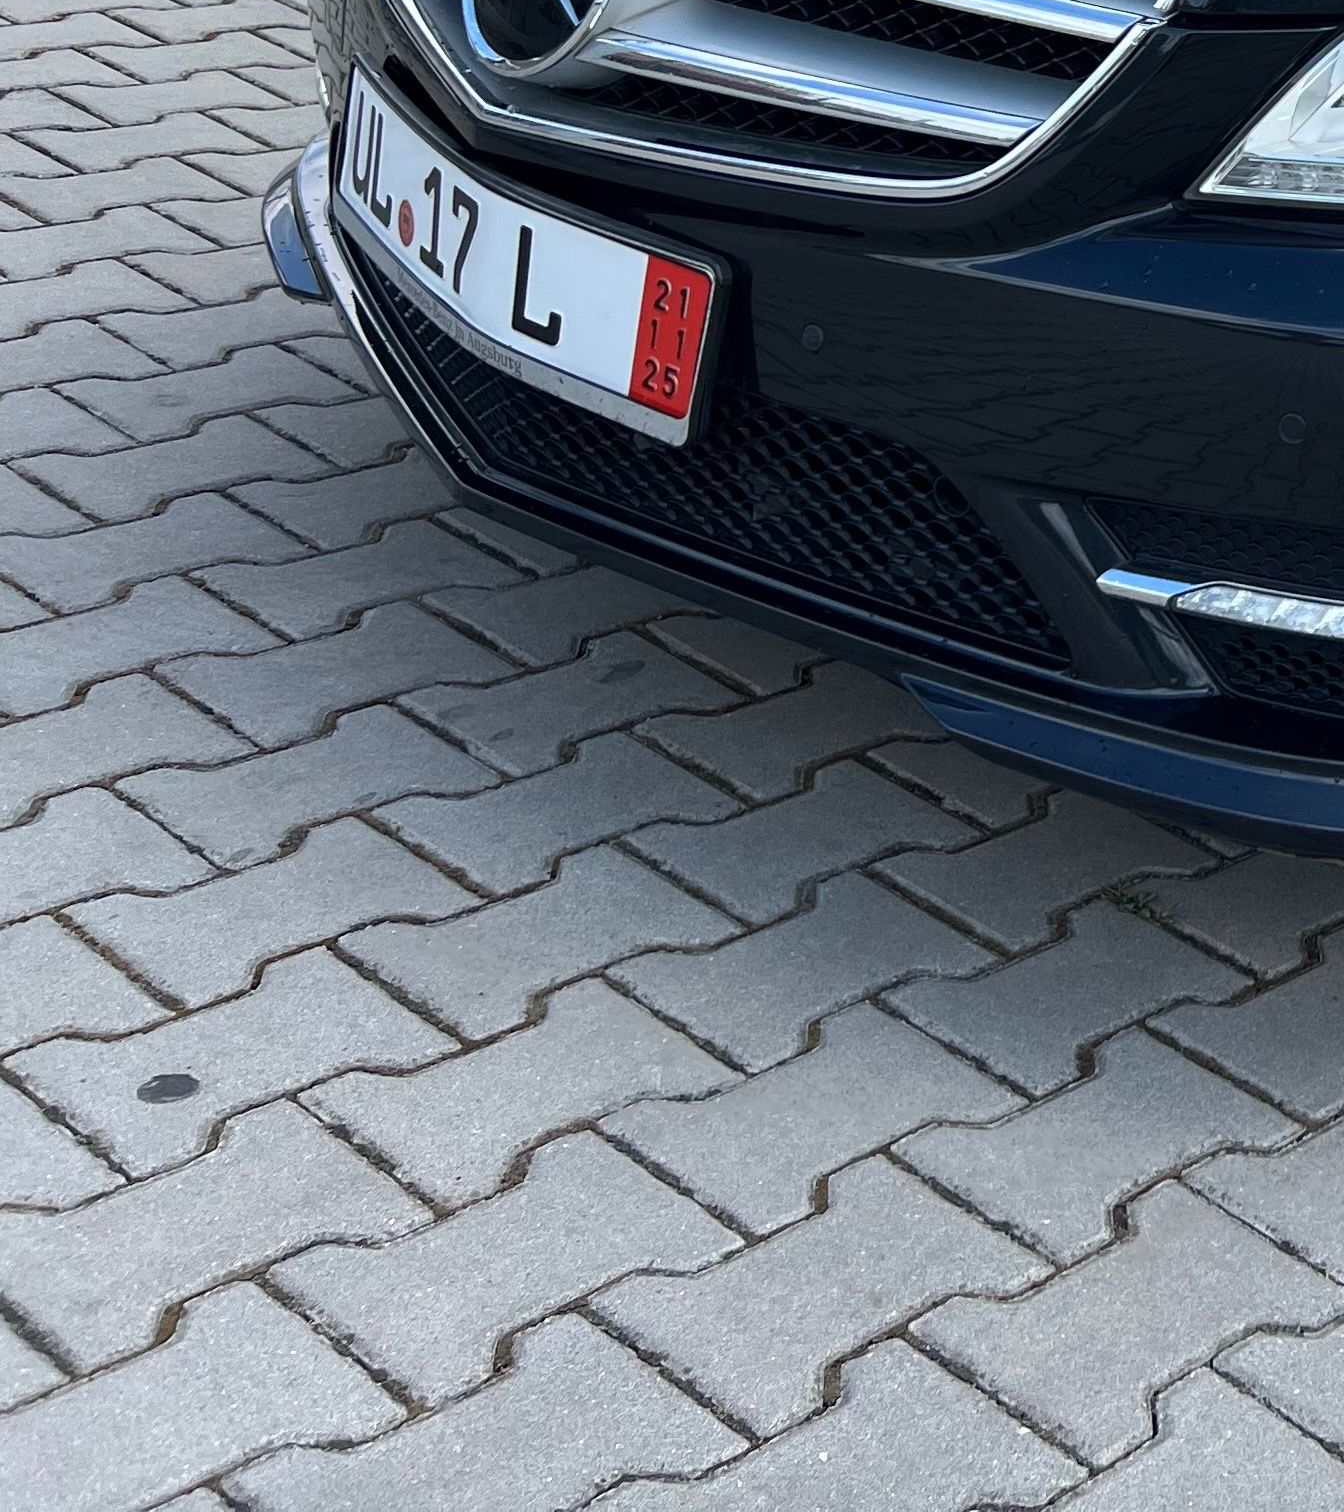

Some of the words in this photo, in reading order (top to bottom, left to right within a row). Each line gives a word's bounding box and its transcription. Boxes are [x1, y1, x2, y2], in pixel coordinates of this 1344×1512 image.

[353, 90, 393, 228] UL
[419, 166, 480, 296] 17
[511, 224, 562, 347] L
[653, 277, 691, 319] 21
[467, 332, 523, 378] Augsburg
[642, 356, 681, 399] 25
